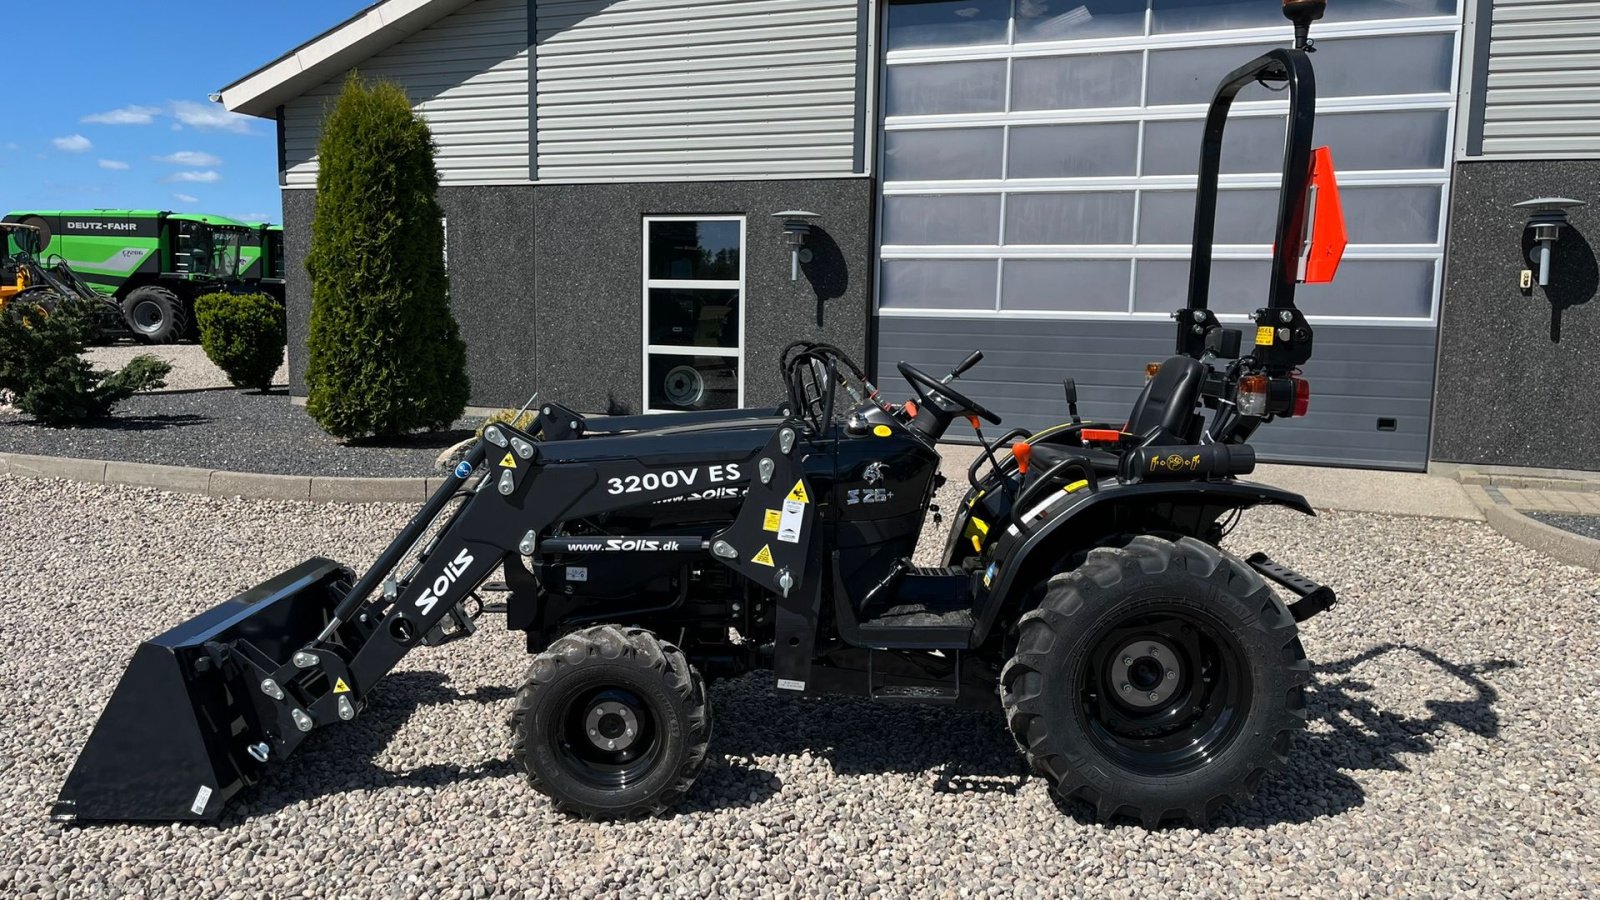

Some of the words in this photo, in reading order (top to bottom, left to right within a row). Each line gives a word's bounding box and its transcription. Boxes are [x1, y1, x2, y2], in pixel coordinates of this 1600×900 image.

[67, 221, 137, 230] DEUTZ-FAHR
[607, 468, 699, 495] 3200V
[709, 463, 741, 482] ES
[847, 489, 860, 505] S
[567, 539, 680, 551] www.Solis.dk
[414, 547, 475, 616] Solis
